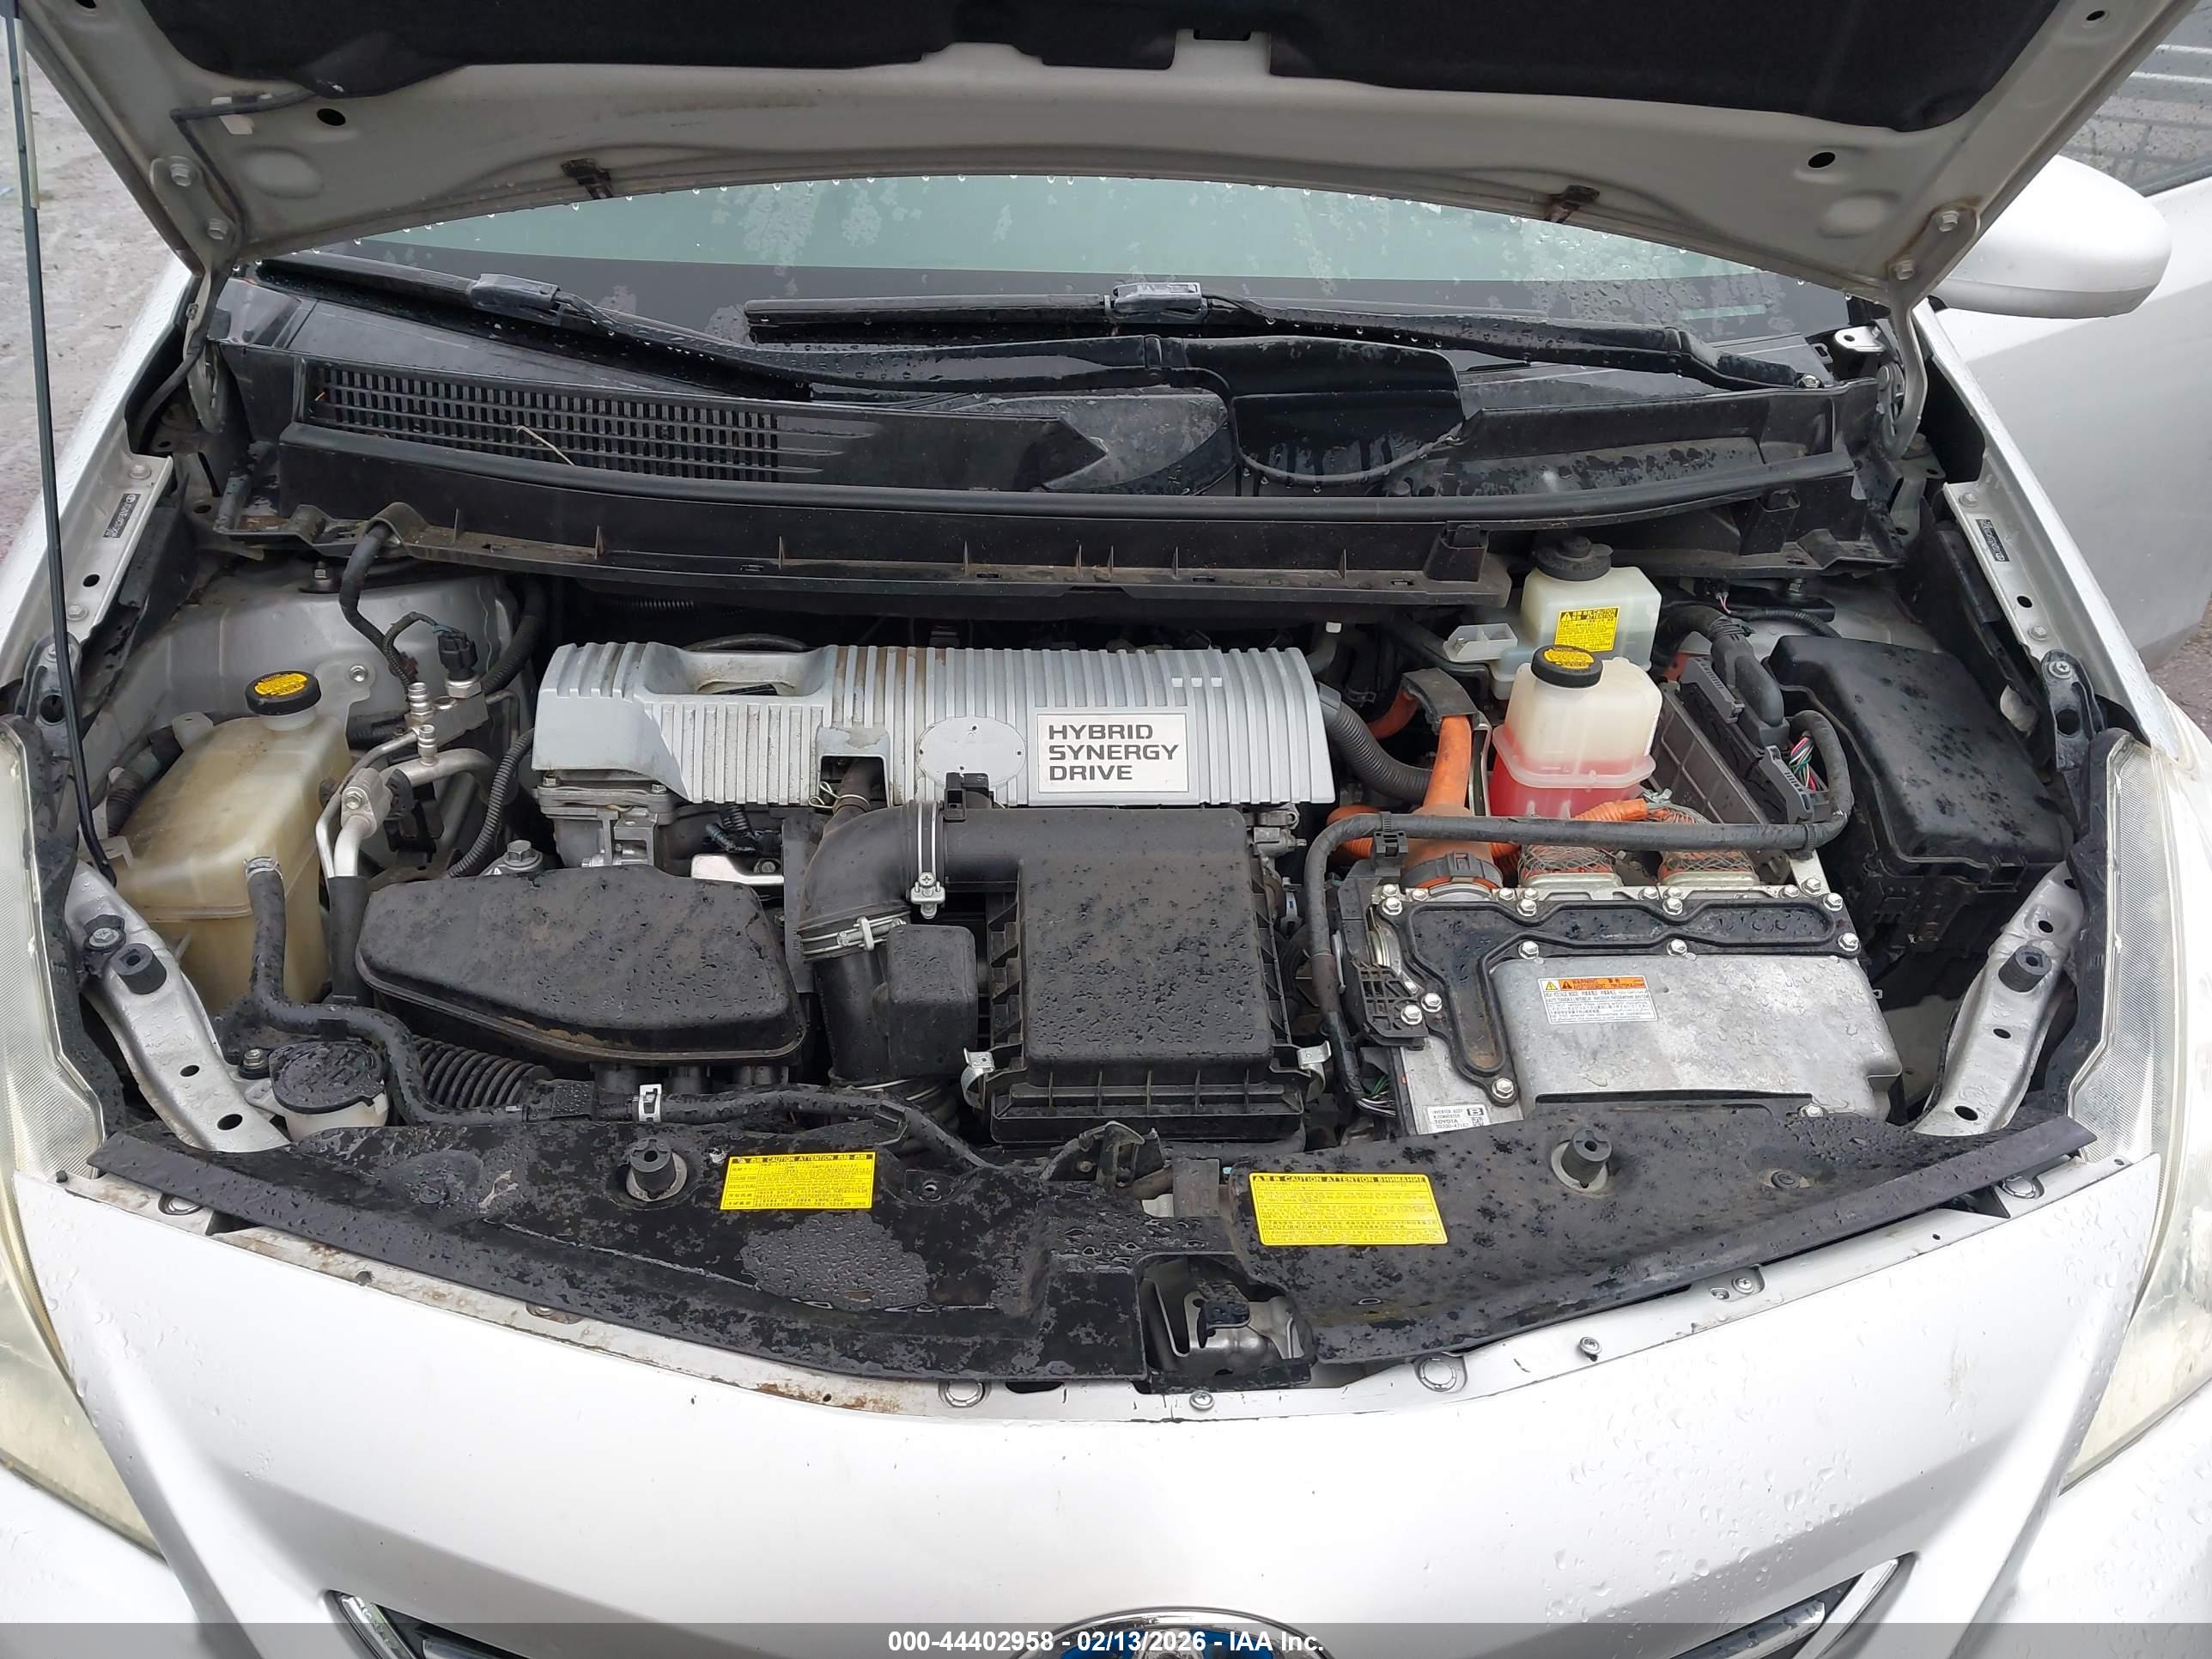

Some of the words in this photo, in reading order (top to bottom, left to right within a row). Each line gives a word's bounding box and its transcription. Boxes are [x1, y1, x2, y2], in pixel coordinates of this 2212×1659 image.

[1048, 725, 1152, 739] HYBRID
[1048, 744, 1179, 760] SYNERGY
[1049, 765, 1133, 781] DRIVE
